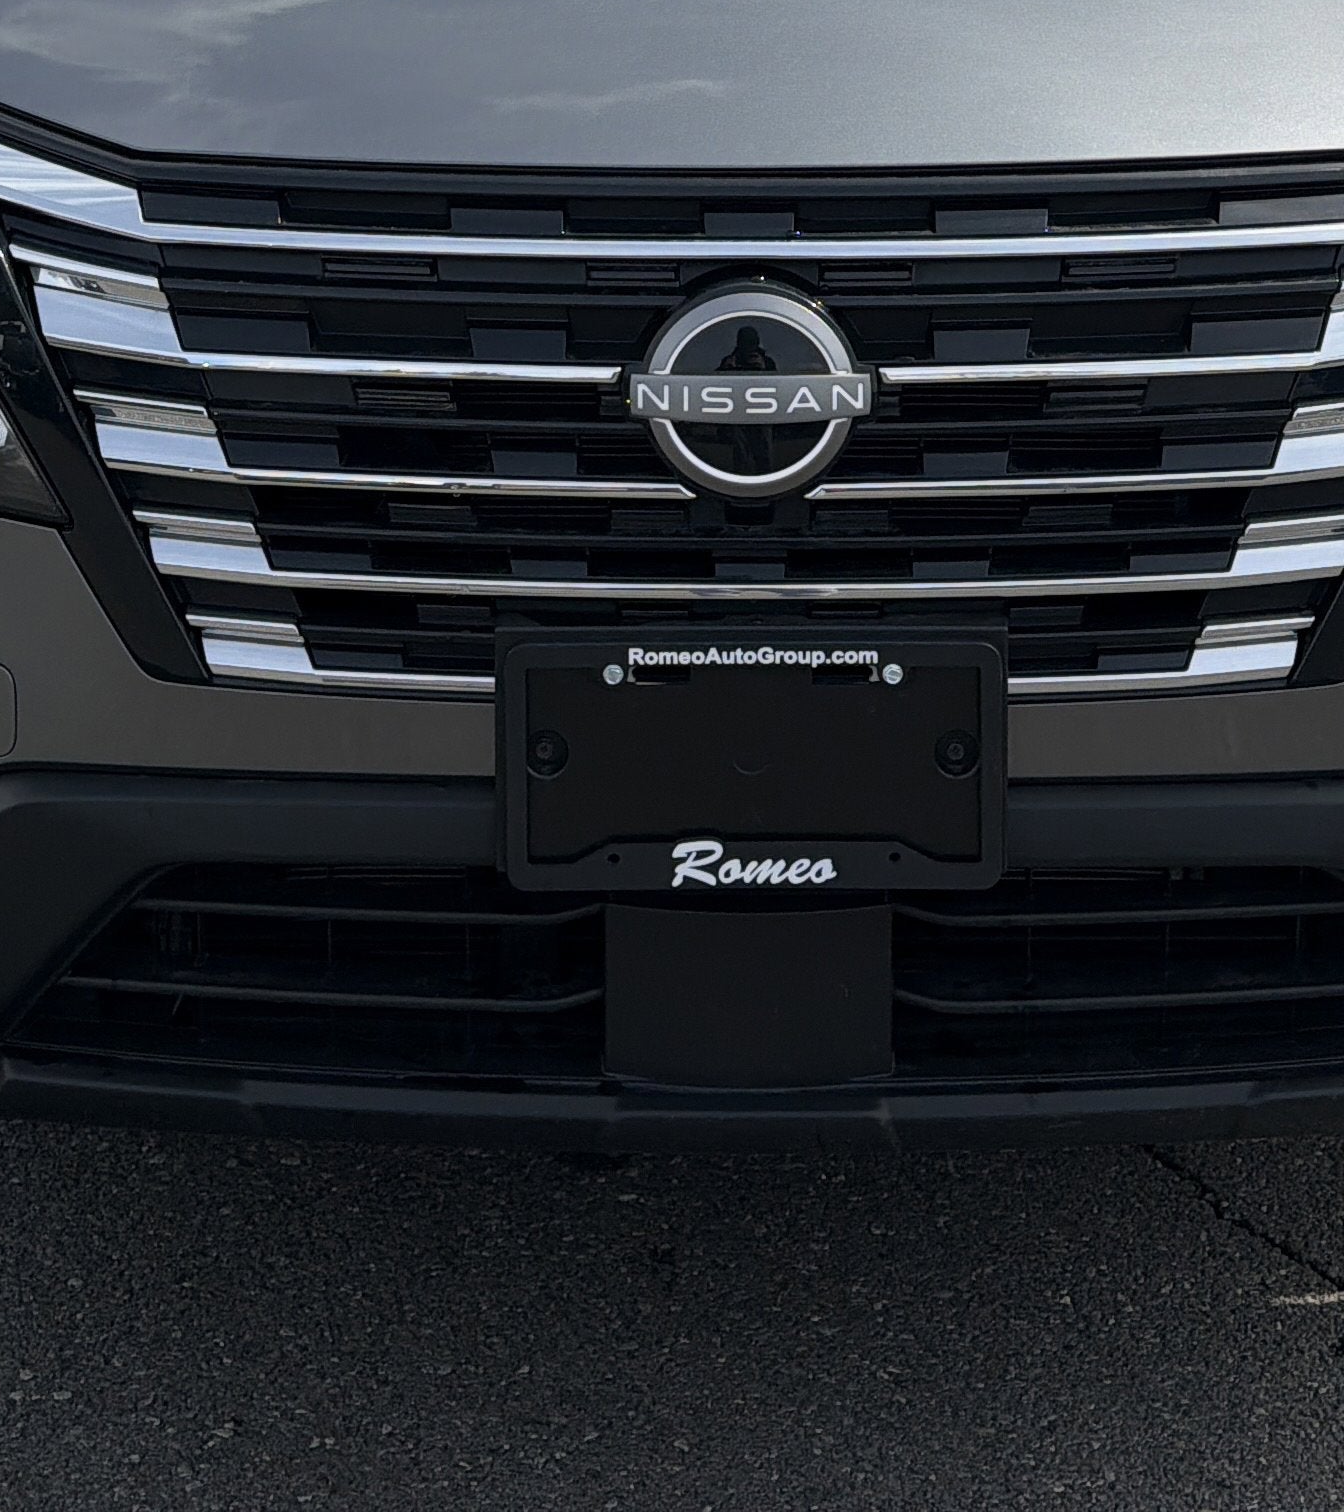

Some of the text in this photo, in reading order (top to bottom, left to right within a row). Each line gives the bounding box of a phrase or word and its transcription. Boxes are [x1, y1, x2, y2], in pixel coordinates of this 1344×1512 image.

[637, 383, 864, 414] NISSAN
[628, 647, 878, 668] RomeoAutoGroup.com
[671, 840, 838, 888] Romeo
